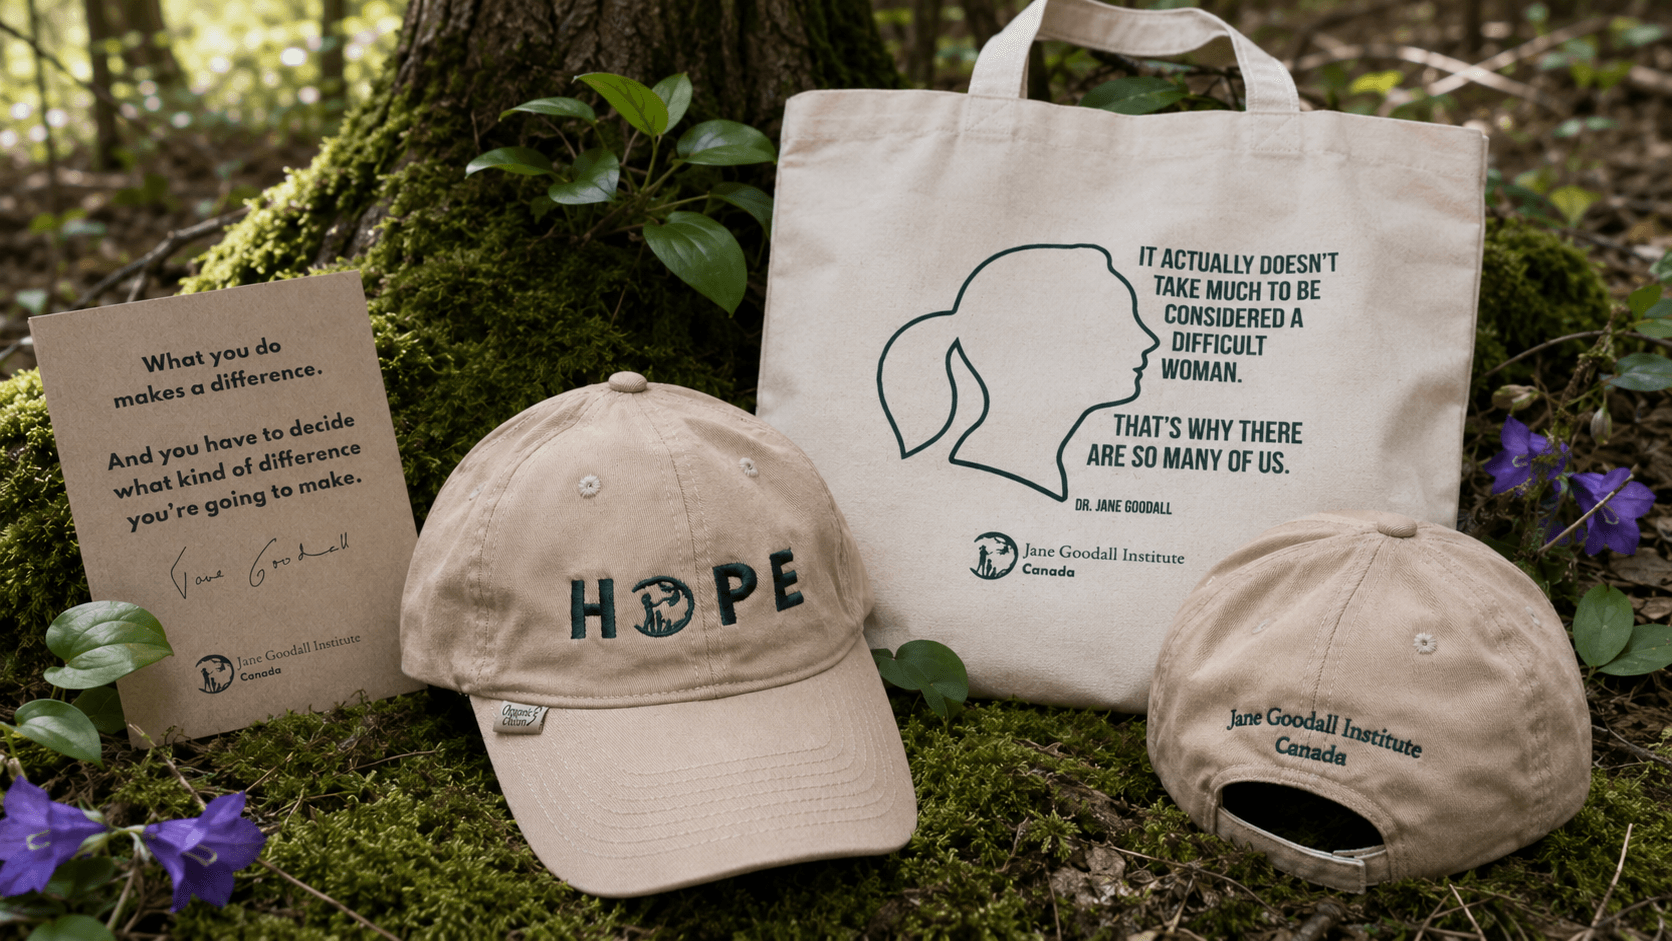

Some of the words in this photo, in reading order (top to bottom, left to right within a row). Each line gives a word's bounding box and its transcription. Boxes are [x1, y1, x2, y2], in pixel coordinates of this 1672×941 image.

[1139, 246, 1157, 266] IT
[1161, 248, 1254, 274] ACTUALLY
[1260, 252, 1338, 274] DOESN’T
[1154, 275, 1201, 298] TAKE
[1206, 280, 1261, 301] MUCH
[1268, 281, 1290, 301] TO
[1297, 280, 1320, 300] BE
[1165, 304, 1284, 328] CONSIDERED
[1290, 308, 1303, 328] A
[142, 351, 205, 372] What
[209, 347, 249, 367] you
[256, 337, 281, 355] do
[1172, 331, 1267, 355] DIFFICULT
[1162, 358, 1242, 382] WOMAN.
[114, 385, 185, 408] makes
[191, 384, 204, 395] a
[211, 366, 322, 391] difference.
[108, 448, 153, 470] And
[158, 444, 198, 465] you
[204, 434, 257, 452] have
[263, 428, 283, 441] to
[290, 412, 354, 436] decide
[1114, 414, 1181, 438] THAT’S
[1188, 418, 1233, 441] WHY
[1239, 420, 1302, 444] THERE
[113, 476, 173, 499] what
[177, 462, 226, 487] kind
[233, 457, 252, 476] of
[259, 444, 360, 471] difference
[1087, 444, 1126, 467] ARE
[1132, 445, 1157, 468] SO
[1163, 447, 1222, 471] MANY
[1228, 450, 1253, 472] OF
[1259, 451, 1289, 474] US.
[127, 503, 198, 532] you’re
[205, 491, 266, 517] going
[271, 485, 293, 498] to
[299, 471, 361, 494] make.
[1076, 499, 1092, 511] DR.
[1095, 499, 1122, 512] JANE
[1125, 500, 1172, 514] GOODALL
[1023, 543, 1054, 559] Jane
[1059, 546, 1117, 560] Goodall
[1123, 549, 1184, 564] Institute
[1023, 563, 1074, 577] Canada
[237, 656, 262, 671] Jane
[265, 642, 310, 660] Goodall
[314, 636, 361, 650] Institute
[240, 667, 281, 681] Canada
[1227, 709, 1262, 730] Jane
[1267, 708, 1339, 734] Goodall
[1342, 718, 1422, 760] Institute
[1275, 736, 1346, 765] Canada
